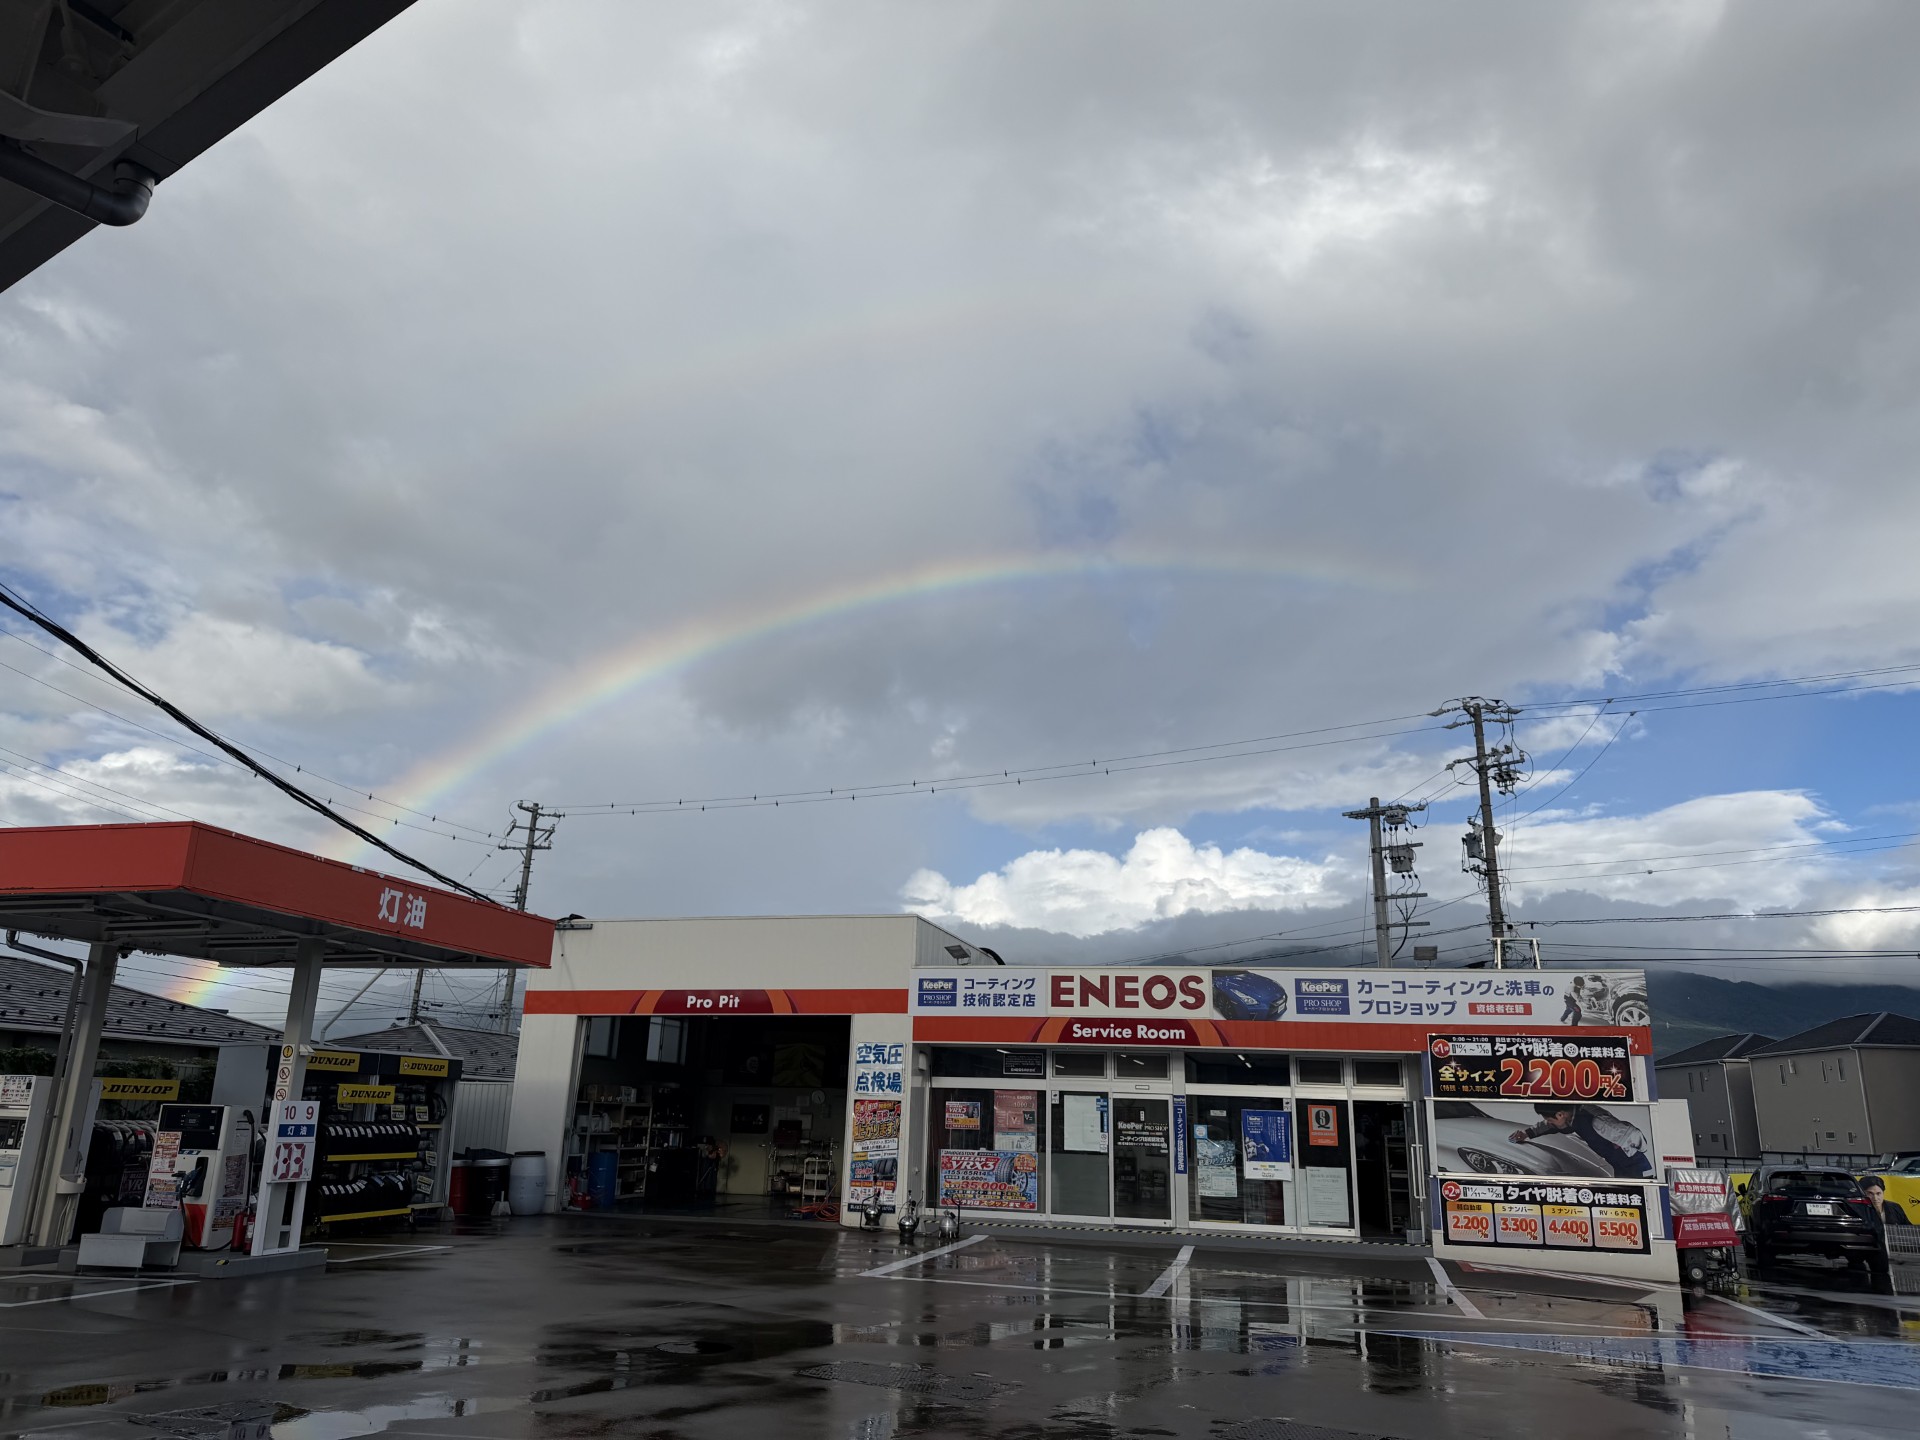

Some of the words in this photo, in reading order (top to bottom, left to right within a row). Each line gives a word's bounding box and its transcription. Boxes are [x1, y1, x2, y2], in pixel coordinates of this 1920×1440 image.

[378, 887, 427, 930] 灯油
[922, 980, 954, 991] KeePer
[964, 977, 1036, 990] コーティング
[1301, 980, 1344, 994] KeePer
[1357, 979, 1554, 996] カーコーティングと洗車の
[1051, 974, 1206, 1010] ENEOS
[686, 995, 713, 1009] Pro
[719, 994, 740, 1008] Pit
[963, 993, 1036, 1007] 技術認定店
[1303, 999, 1321, 1007] PRO
[1321, 999, 1342, 1007] SHOP
[1358, 999, 1457, 1016] プロショップ
[1476, 1003, 1525, 1014] 資格者在籍
[1072, 1023, 1133, 1039] Service
[1136, 1024, 1186, 1040] Room
[856, 1044, 904, 1065] 空気圧
[1494, 1042, 1564, 1057] タイヤ脱着
[1579, 1046, 1626, 1058] 作業料金
[309, 1056, 355, 1066] DUNLOP
[410, 1063, 445, 1072] DUNLOP
[1438, 1065, 1497, 1082] 全サイズ
[108, 1084, 174, 1094] DUNLOP
[856, 1072, 903, 1093] 点検場
[350, 1090, 391, 1098] DUNLOP
[284, 1106, 296, 1120] 10
[306, 1106, 314, 1120] 9
[287, 1125, 308, 1136] 灯油
[1117, 1121, 1143, 1130] KeePer
[951, 1161, 995, 1170] VRX3
[1678, 1184, 1722, 1193] 緊急用発電機
[1506, 1186, 1578, 1204] タイヤ脱着
[1594, 1192, 1643, 1206] 作業料金
[1684, 1221, 1730, 1231] 緊急用発電機
